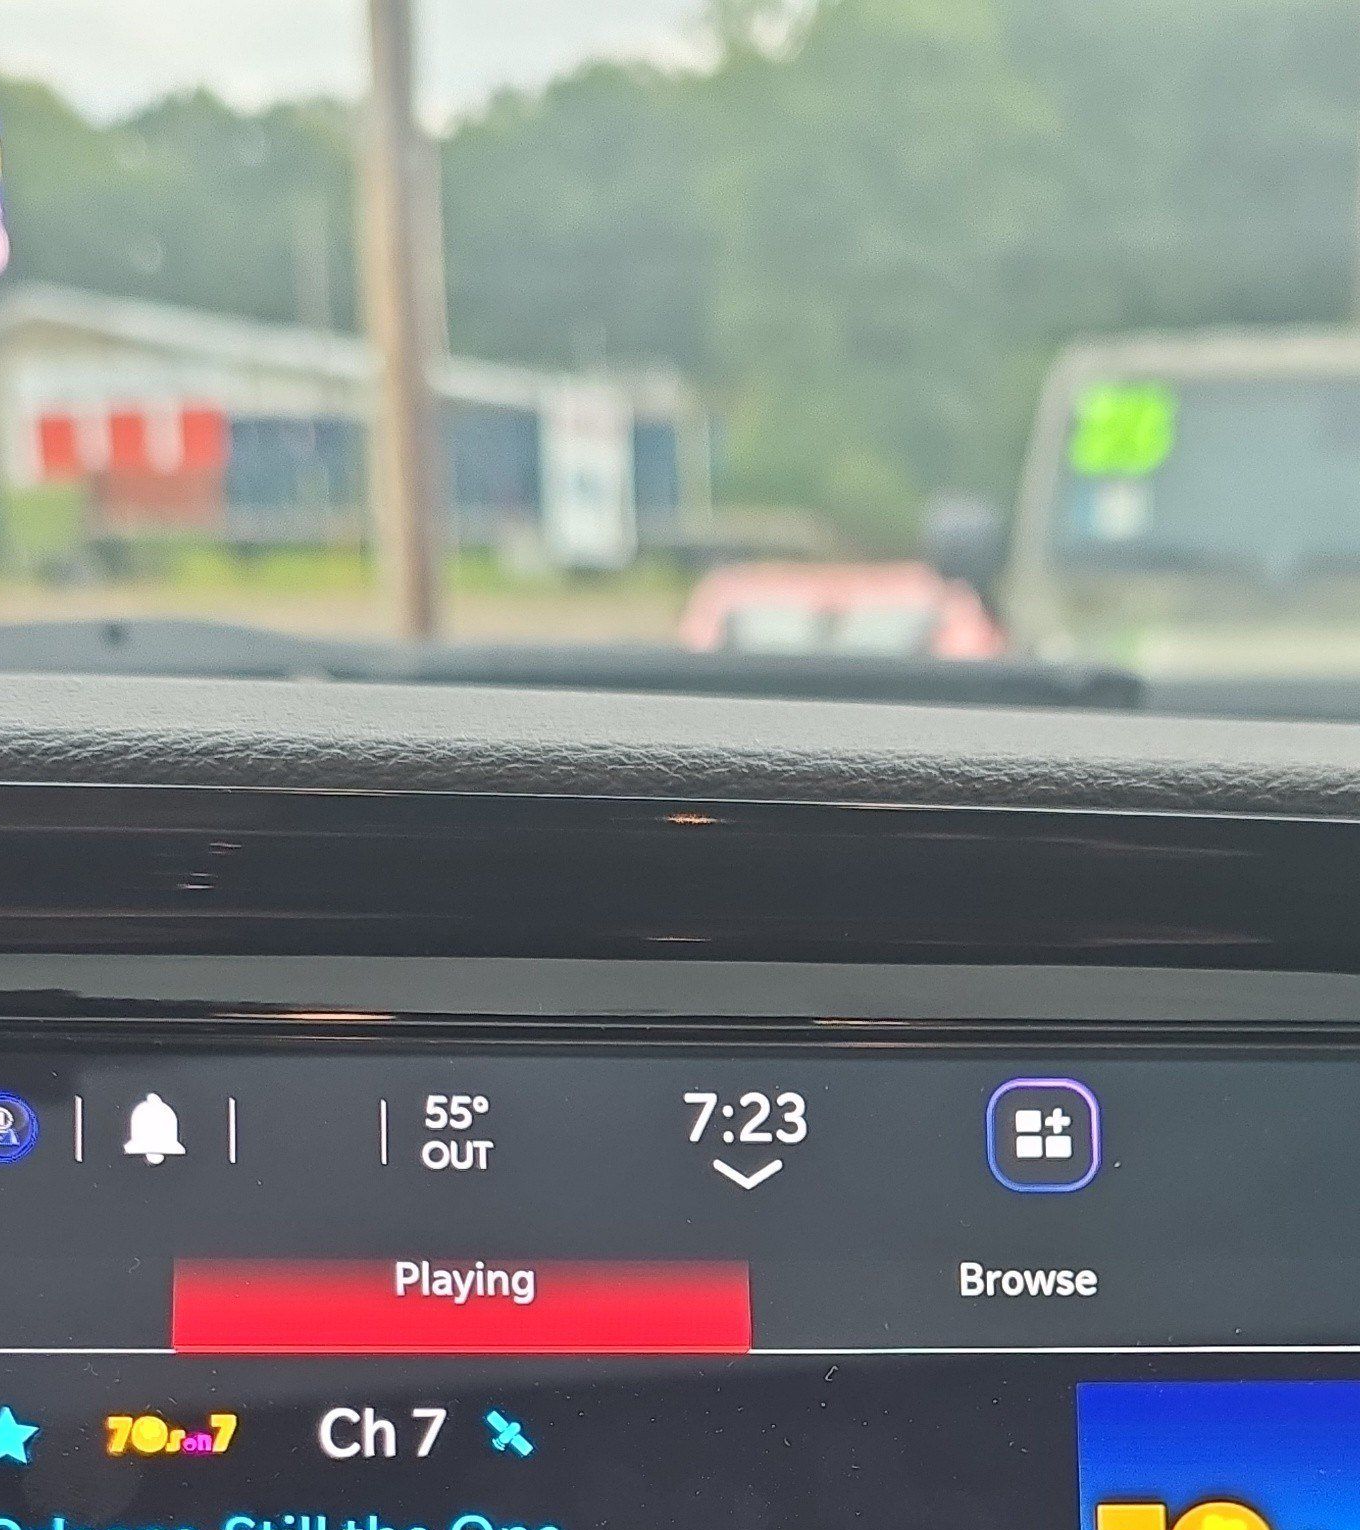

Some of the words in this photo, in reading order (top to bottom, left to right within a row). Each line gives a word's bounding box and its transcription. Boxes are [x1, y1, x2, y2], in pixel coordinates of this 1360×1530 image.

[424, 1094, 490, 1132] 55°
[683, 1092, 808, 1145] 7:23
[421, 1141, 493, 1171] OUT
[394, 1261, 535, 1303] Playing
[958, 1262, 1097, 1298] Browse
[318, 1407, 396, 1457] Ch
[412, 1408, 447, 1456] 7
